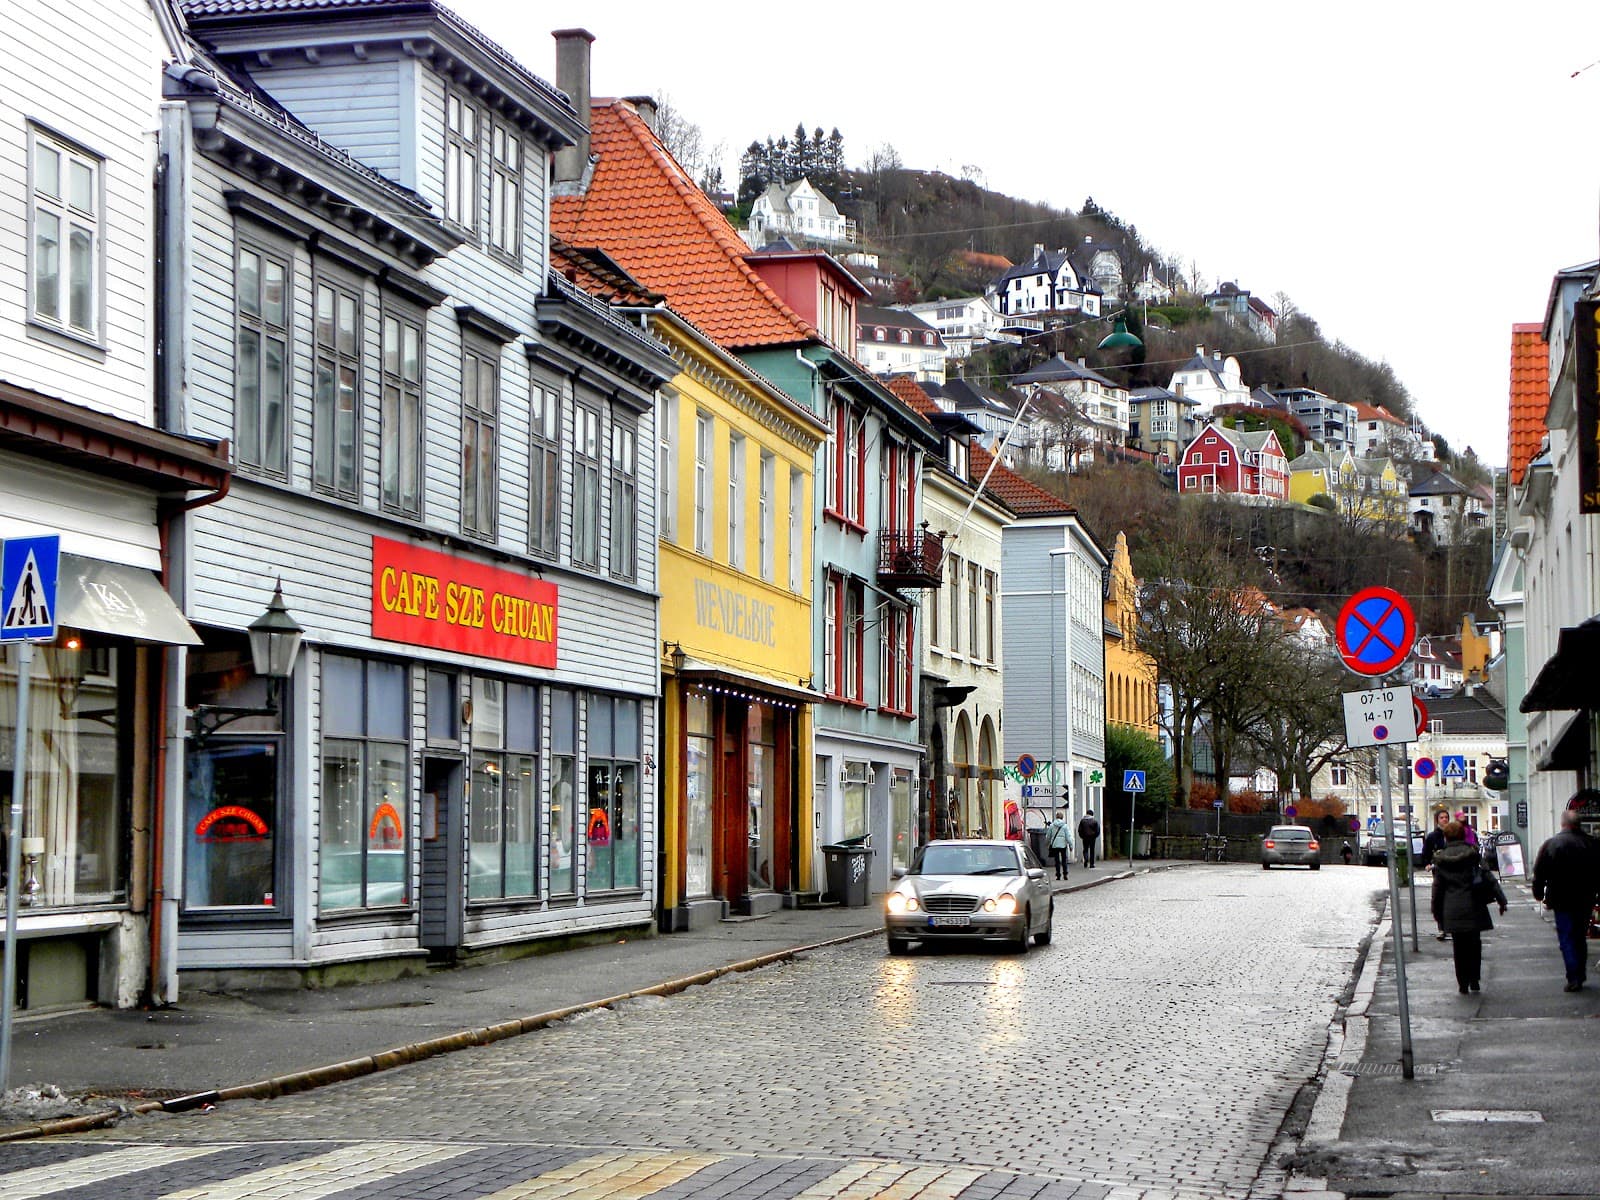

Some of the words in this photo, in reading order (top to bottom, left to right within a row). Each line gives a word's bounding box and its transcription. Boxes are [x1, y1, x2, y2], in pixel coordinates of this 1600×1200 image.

[380, 565, 440, 620] CAFE
[445, 581, 486, 629] SZE
[490, 592, 554, 643] CHUAN
[694, 577, 776, 648] WENDELBOE
